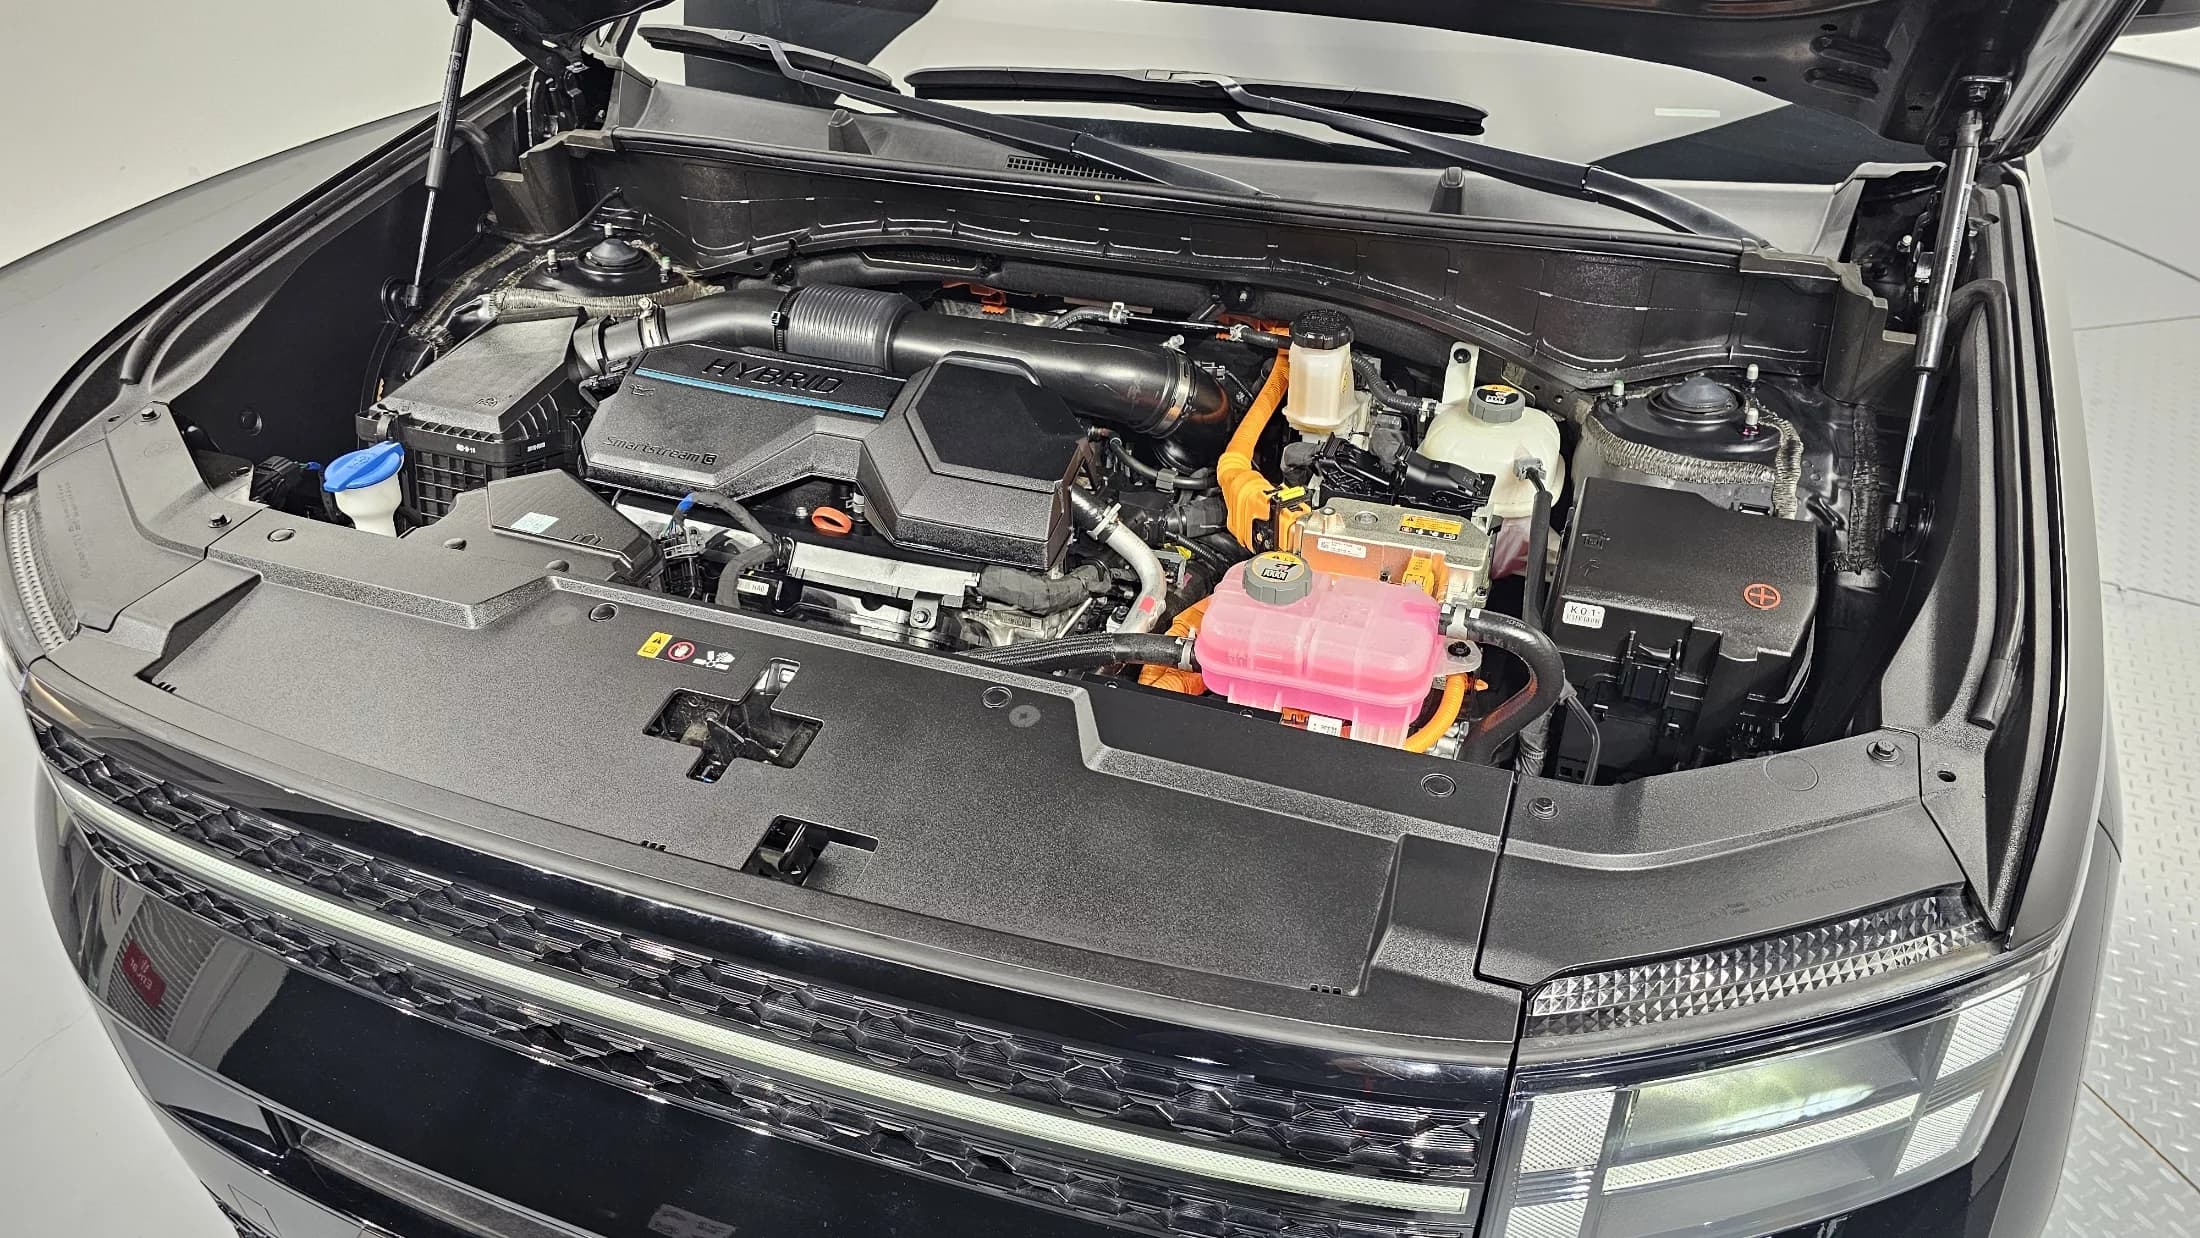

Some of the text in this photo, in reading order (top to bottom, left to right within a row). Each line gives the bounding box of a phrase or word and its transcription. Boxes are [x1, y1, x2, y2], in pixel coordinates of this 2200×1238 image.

[701, 358, 844, 394] HYBRID
[603, 436, 719, 466] Smartstream G
